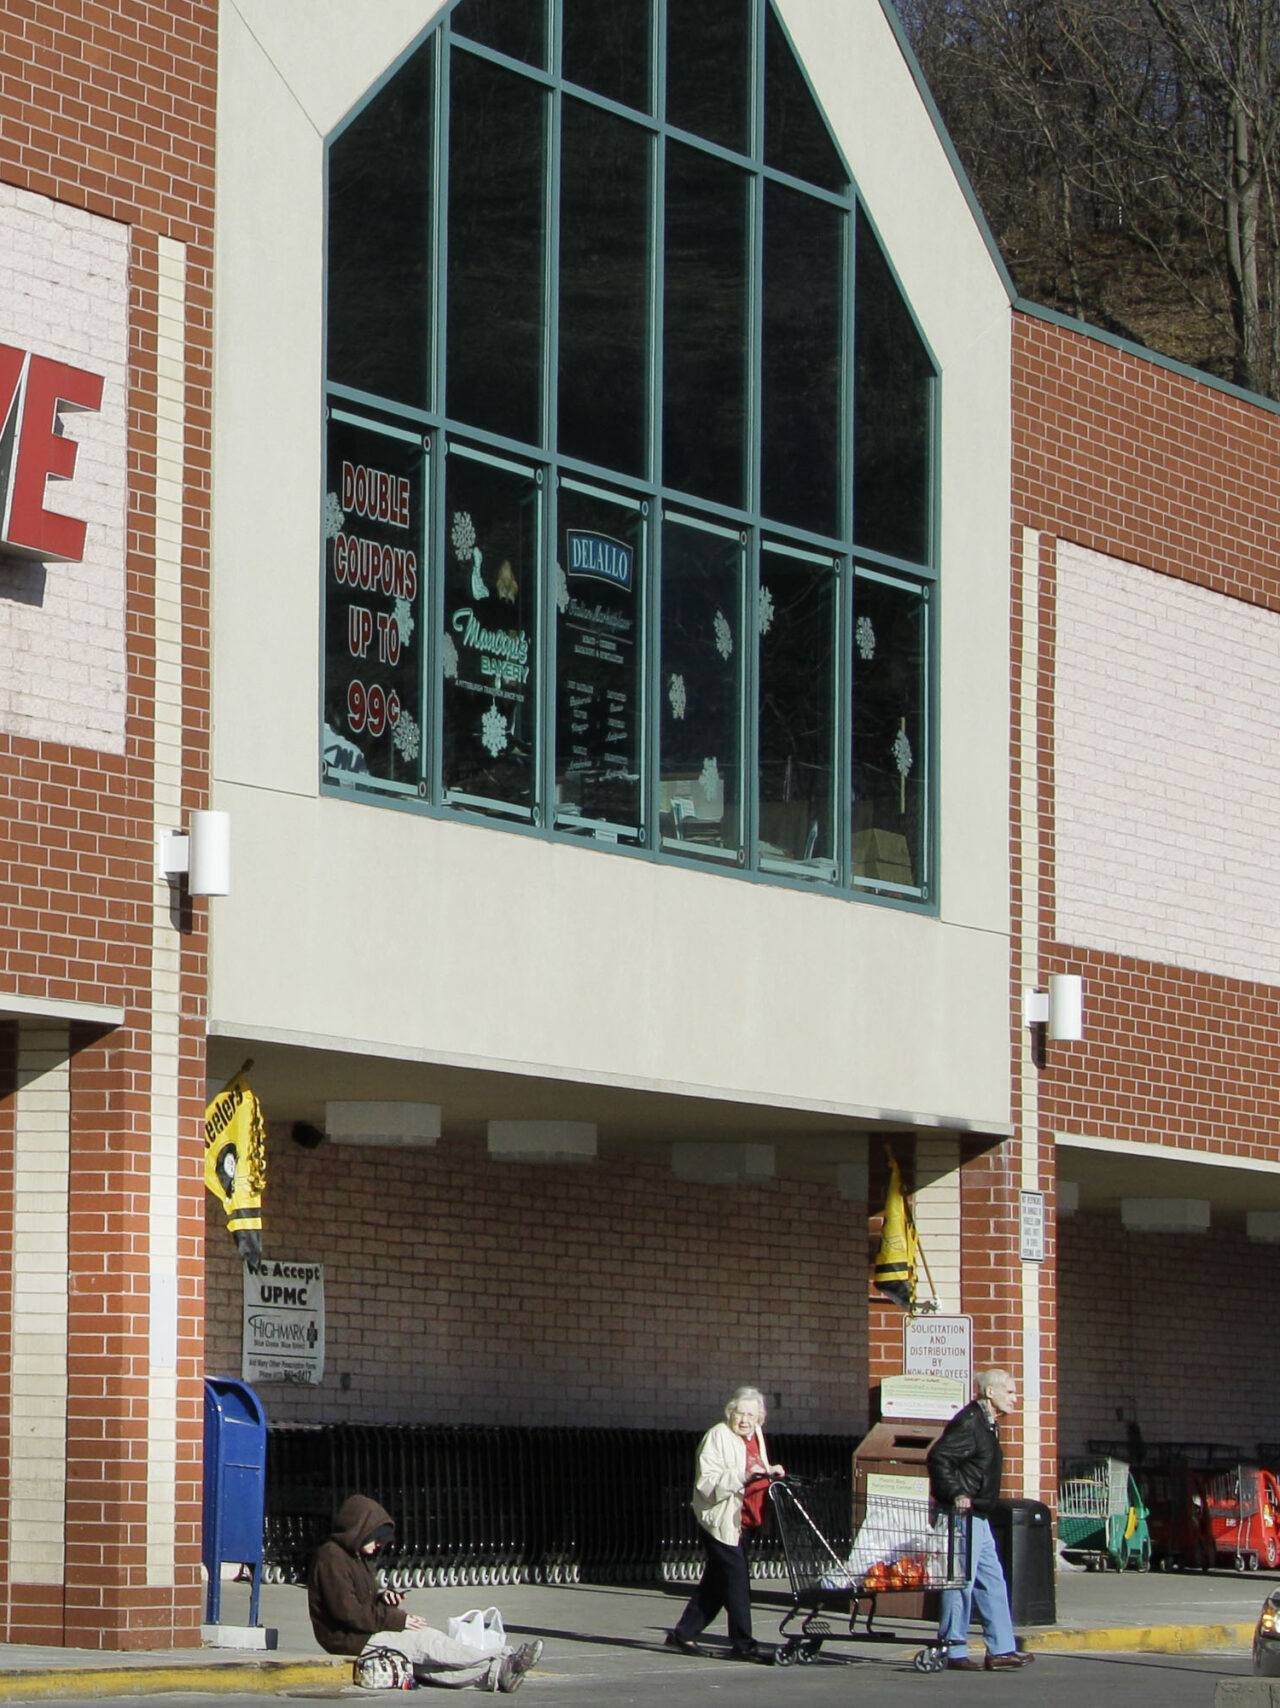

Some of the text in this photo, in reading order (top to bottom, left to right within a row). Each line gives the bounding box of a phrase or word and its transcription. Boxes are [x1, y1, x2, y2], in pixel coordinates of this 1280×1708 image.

[342, 460, 411, 530] DOUBLE
[333, 532, 418, 602] COUPONS
[572, 538, 629, 583] DELALLO
[347, 604, 402, 667] UP TO
[481, 655, 530, 685] BAKERY
[246, 1260, 321, 1285] We Accept
[260, 1284, 308, 1306] UPMC
[250, 1315, 306, 1342] HIGHMARK
[911, 1324, 965, 1334] SOLICITATION
[929, 1335, 946, 1345] AND
[910, 1346, 966, 1356] DISTRIBUTION
[931, 1357, 943, 1367] BY
[907, 1368, 969, 1379] NON-EMPLOYEES
